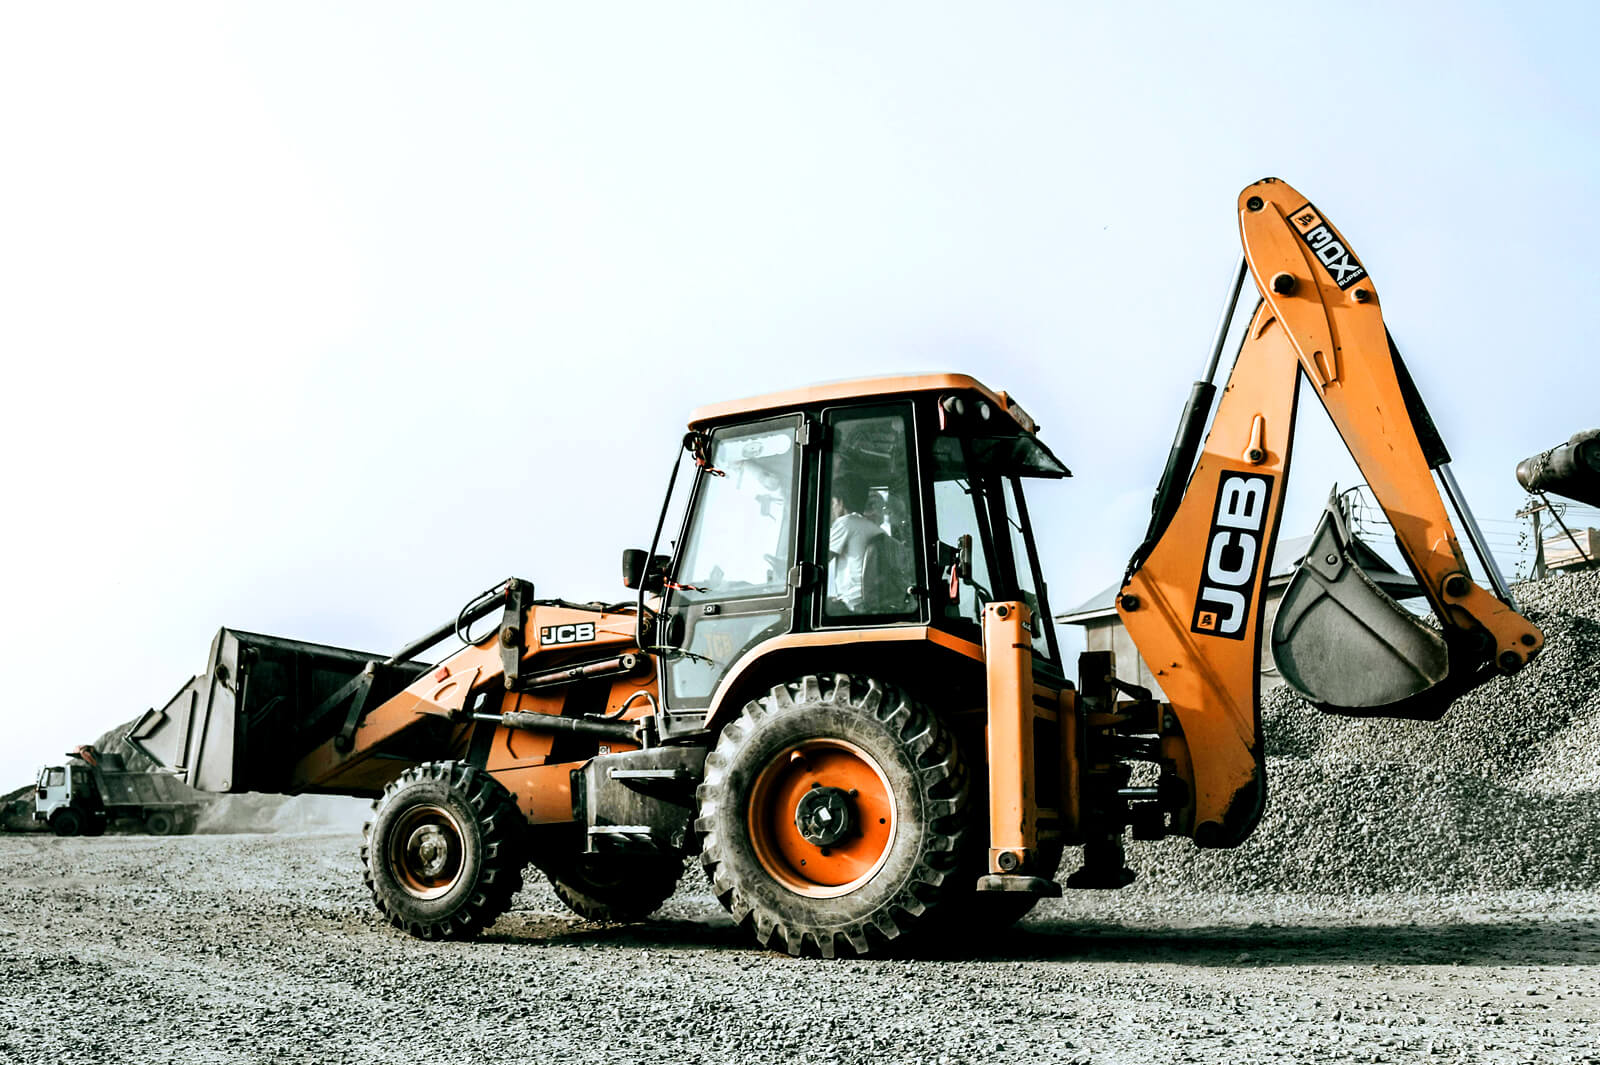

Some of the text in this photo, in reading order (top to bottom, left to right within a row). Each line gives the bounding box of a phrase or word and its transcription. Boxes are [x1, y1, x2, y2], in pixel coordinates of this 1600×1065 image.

[1306, 225, 1360, 282] 3DX
[1338, 268, 1364, 287] SUPER
[1202, 476, 1267, 634] JCB
[541, 623, 595, 645] JCB
